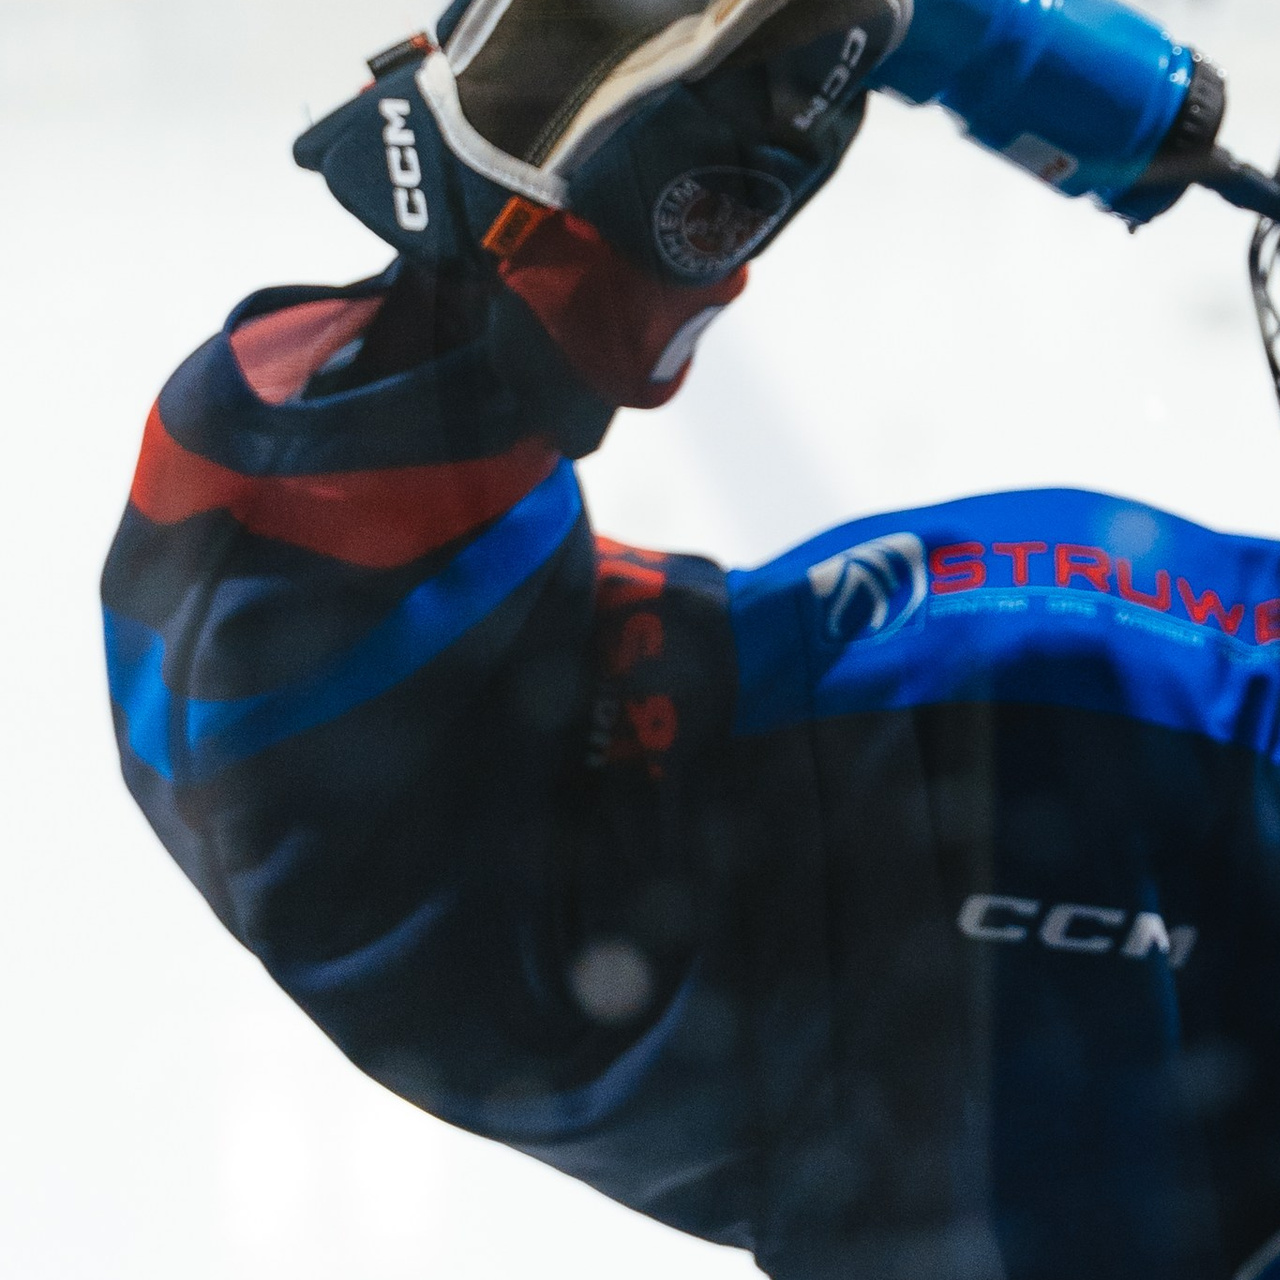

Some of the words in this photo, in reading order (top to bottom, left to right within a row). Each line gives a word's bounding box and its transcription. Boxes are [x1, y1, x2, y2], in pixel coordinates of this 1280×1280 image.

[794, 26, 868, 131] CCM
[378, 97, 429, 231] CCM
[957, 893, 1198, 968] CCM
